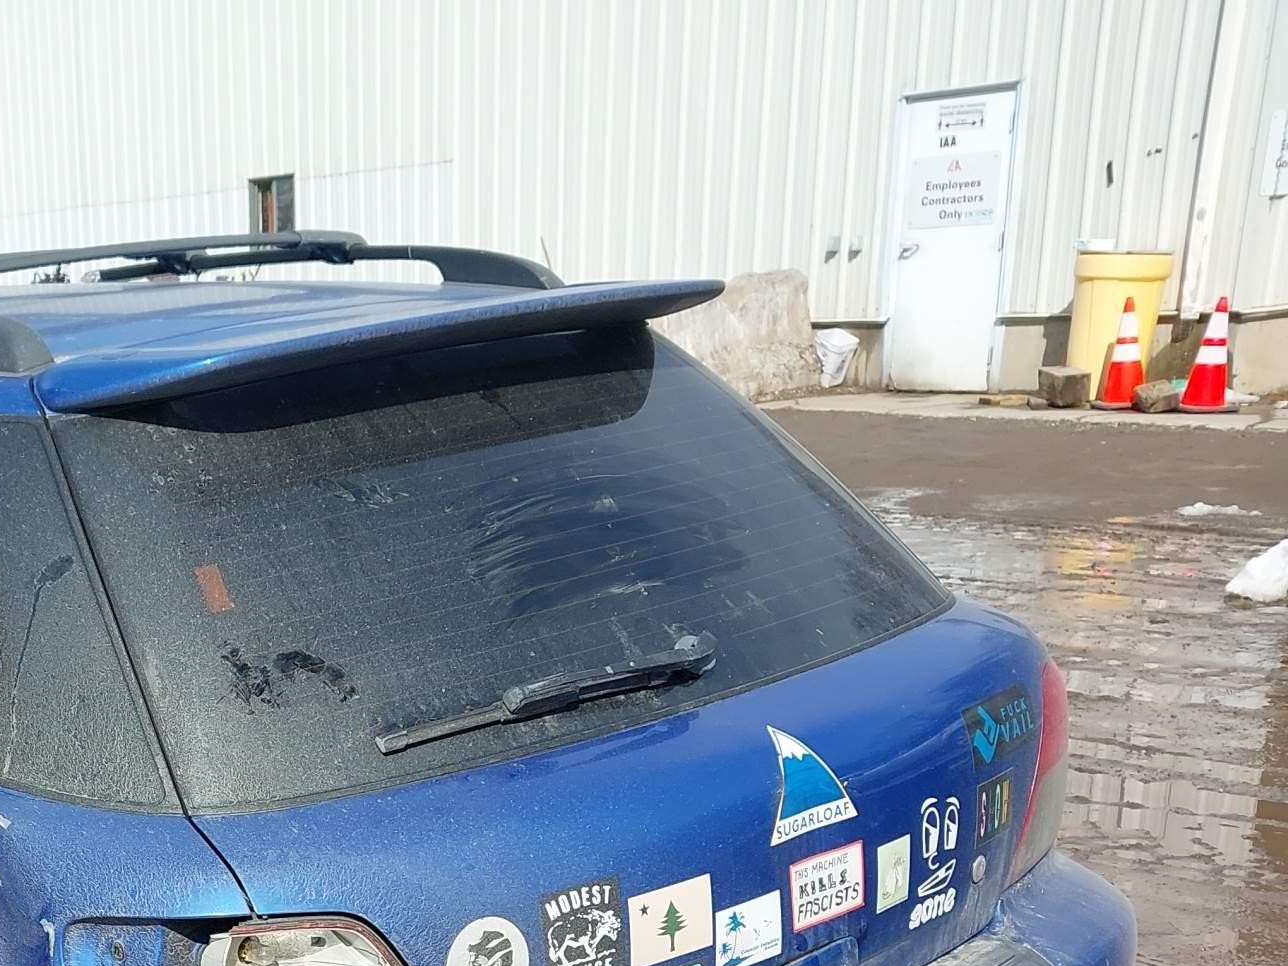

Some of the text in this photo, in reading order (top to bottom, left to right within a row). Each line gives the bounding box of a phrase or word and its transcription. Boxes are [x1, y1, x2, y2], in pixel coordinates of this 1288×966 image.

[939, 135, 957, 149] IAA
[921, 194, 984, 207] Contractors
[925, 180, 982, 193] Employees
[938, 209, 962, 221] Only
[1000, 697, 1027, 720] FUCK
[1000, 711, 1034, 743] VAIL
[776, 801, 850, 840] SUGARLOAF
[794, 852, 849, 882] THIS MACHINE
[798, 868, 849, 899] KILLS
[544, 885, 612, 921] MODEST
[797, 881, 860, 923] FASCISTS
